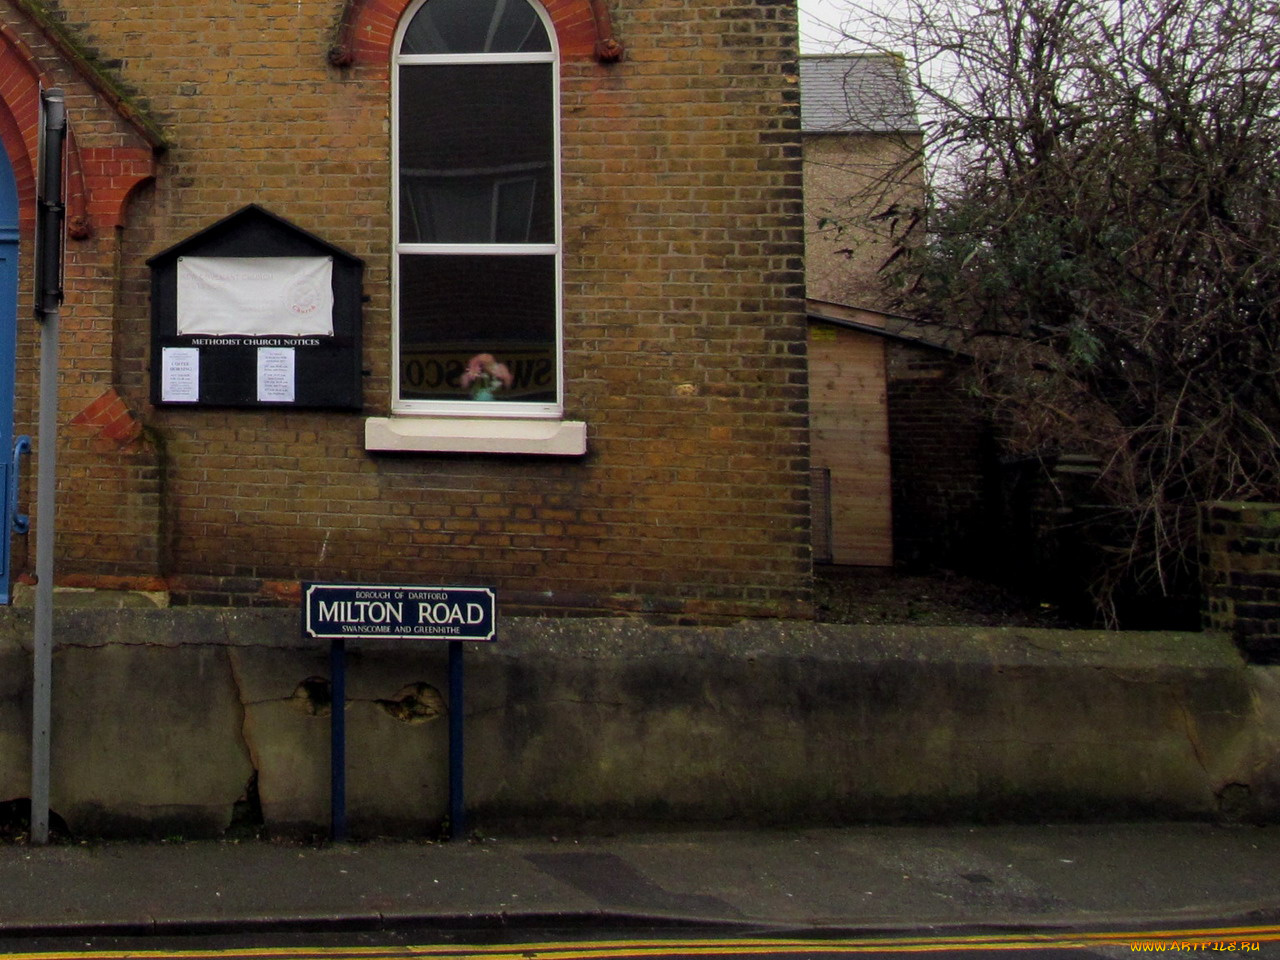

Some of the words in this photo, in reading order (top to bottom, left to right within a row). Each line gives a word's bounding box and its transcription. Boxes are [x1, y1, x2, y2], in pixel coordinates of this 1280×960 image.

[292, 305, 316, 314] Church
[191, 338, 242, 346] METHODIST
[243, 338, 281, 346] CHURCH
[284, 338, 320, 346] NOTICES
[355, 591, 391, 599] BOROUGH
[394, 592, 404, 600] OF
[408, 592, 448, 600] DARTFORD
[318, 600, 403, 624] MILTON
[418, 602, 485, 625] ROAD
[341, 624, 391, 634] SWANSCOMBE
[394, 625, 412, 634] AND
[413, 626, 461, 635] GREENHITHE
